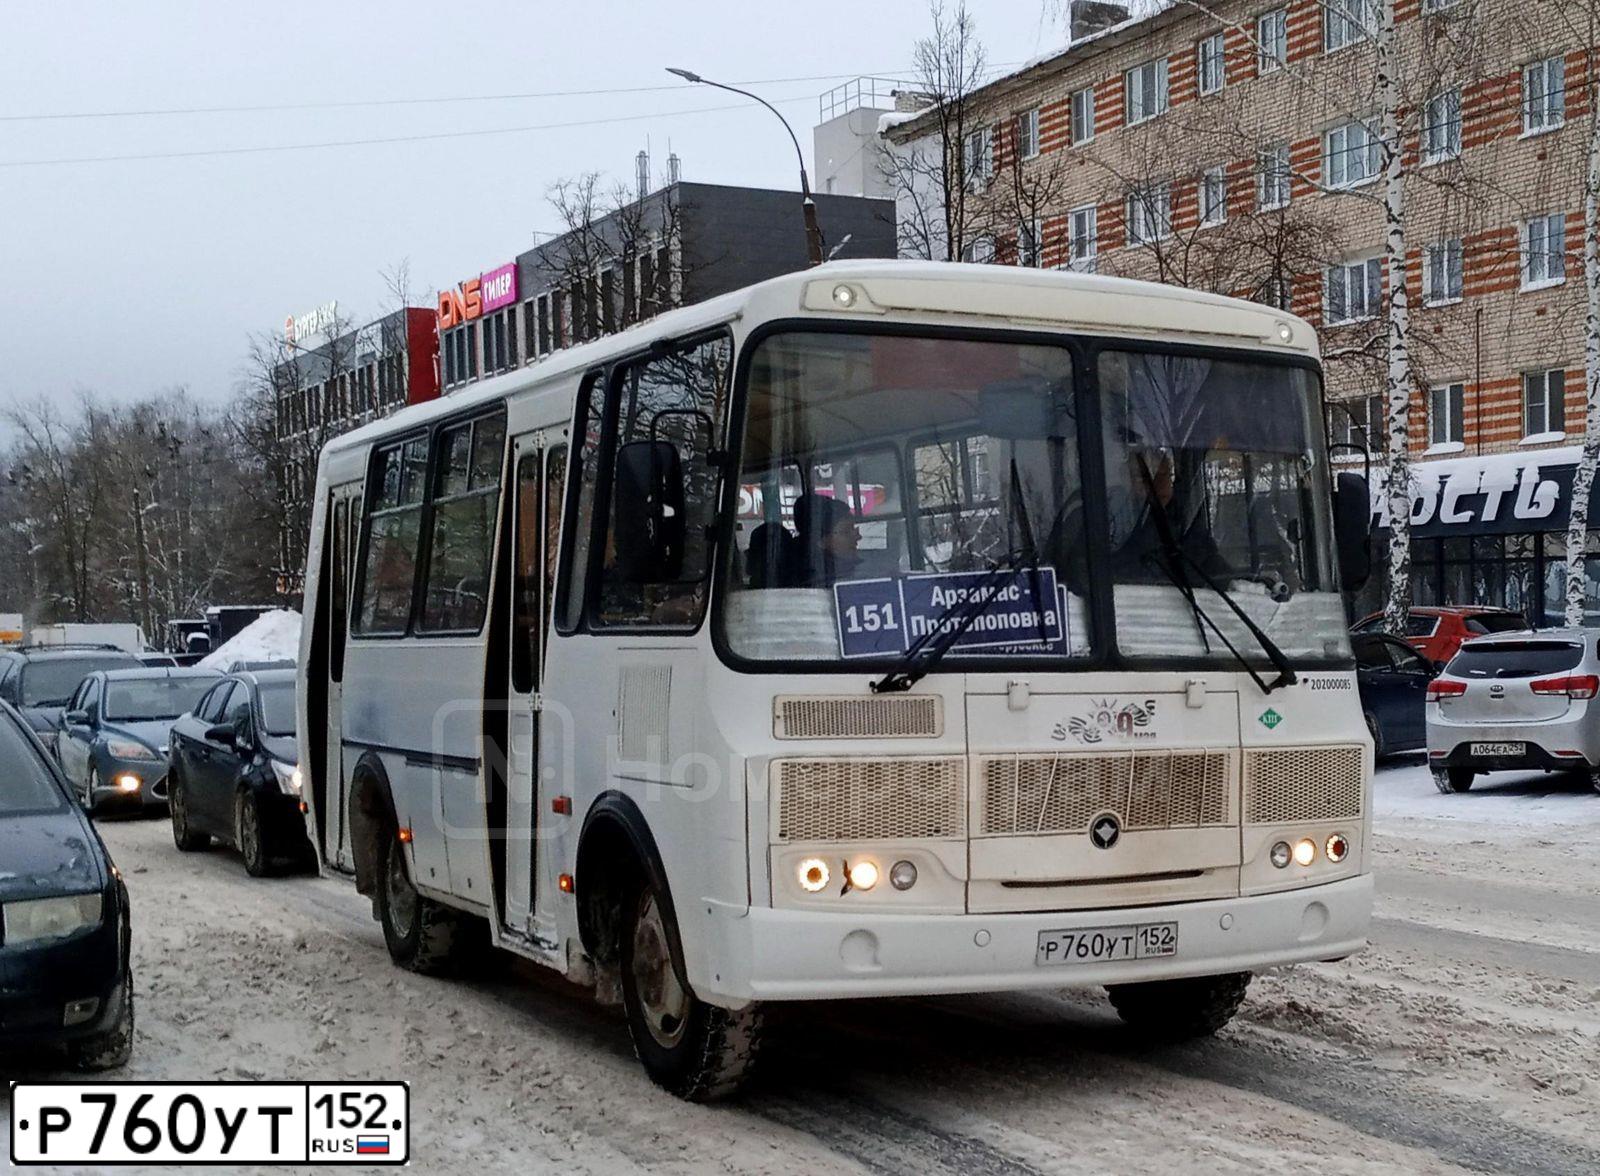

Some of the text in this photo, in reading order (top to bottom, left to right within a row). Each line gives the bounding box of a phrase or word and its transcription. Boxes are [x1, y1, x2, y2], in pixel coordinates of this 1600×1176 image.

[484, 272, 512, 303] ГИПЕР
[438, 279, 482, 330] DNS
[845, 602, 898, 633] 151
[1046, 926, 1171, 961] Р760УТ 152
[1145, 946, 1161, 954] RUS
